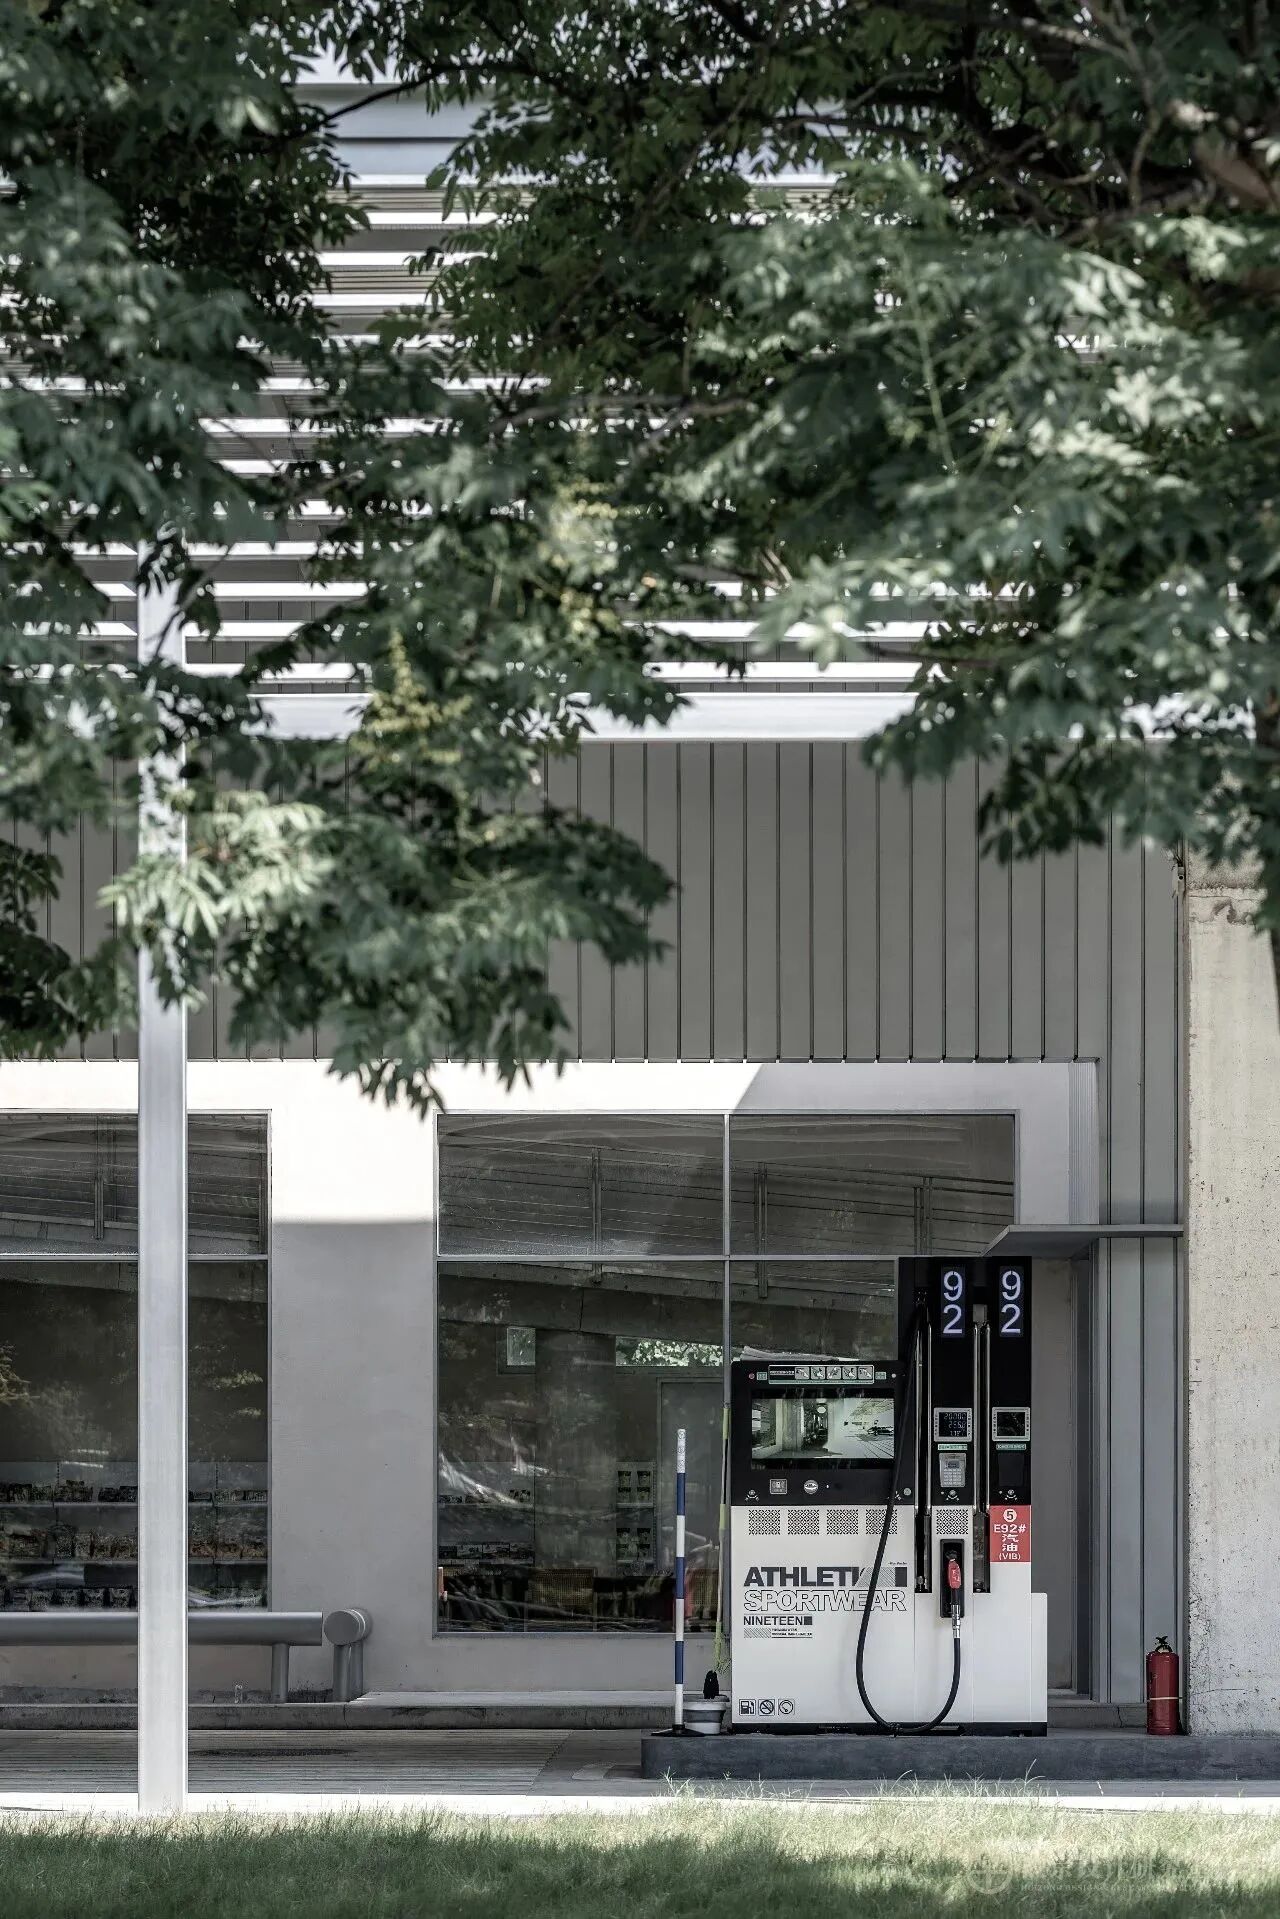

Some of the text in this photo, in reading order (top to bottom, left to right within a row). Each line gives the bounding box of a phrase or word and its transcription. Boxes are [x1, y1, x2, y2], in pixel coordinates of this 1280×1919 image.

[943, 1270, 963, 1334] 92
[1001, 1270, 1021, 1334] 92
[993, 1523, 1026, 1533] E92#
[1002, 1533, 1019, 1552] 汽油
[999, 1553, 1021, 1561] (VIB)
[743, 1589, 908, 1612] SPORTWEAR
[743, 1616, 803, 1626] NINETEEN
